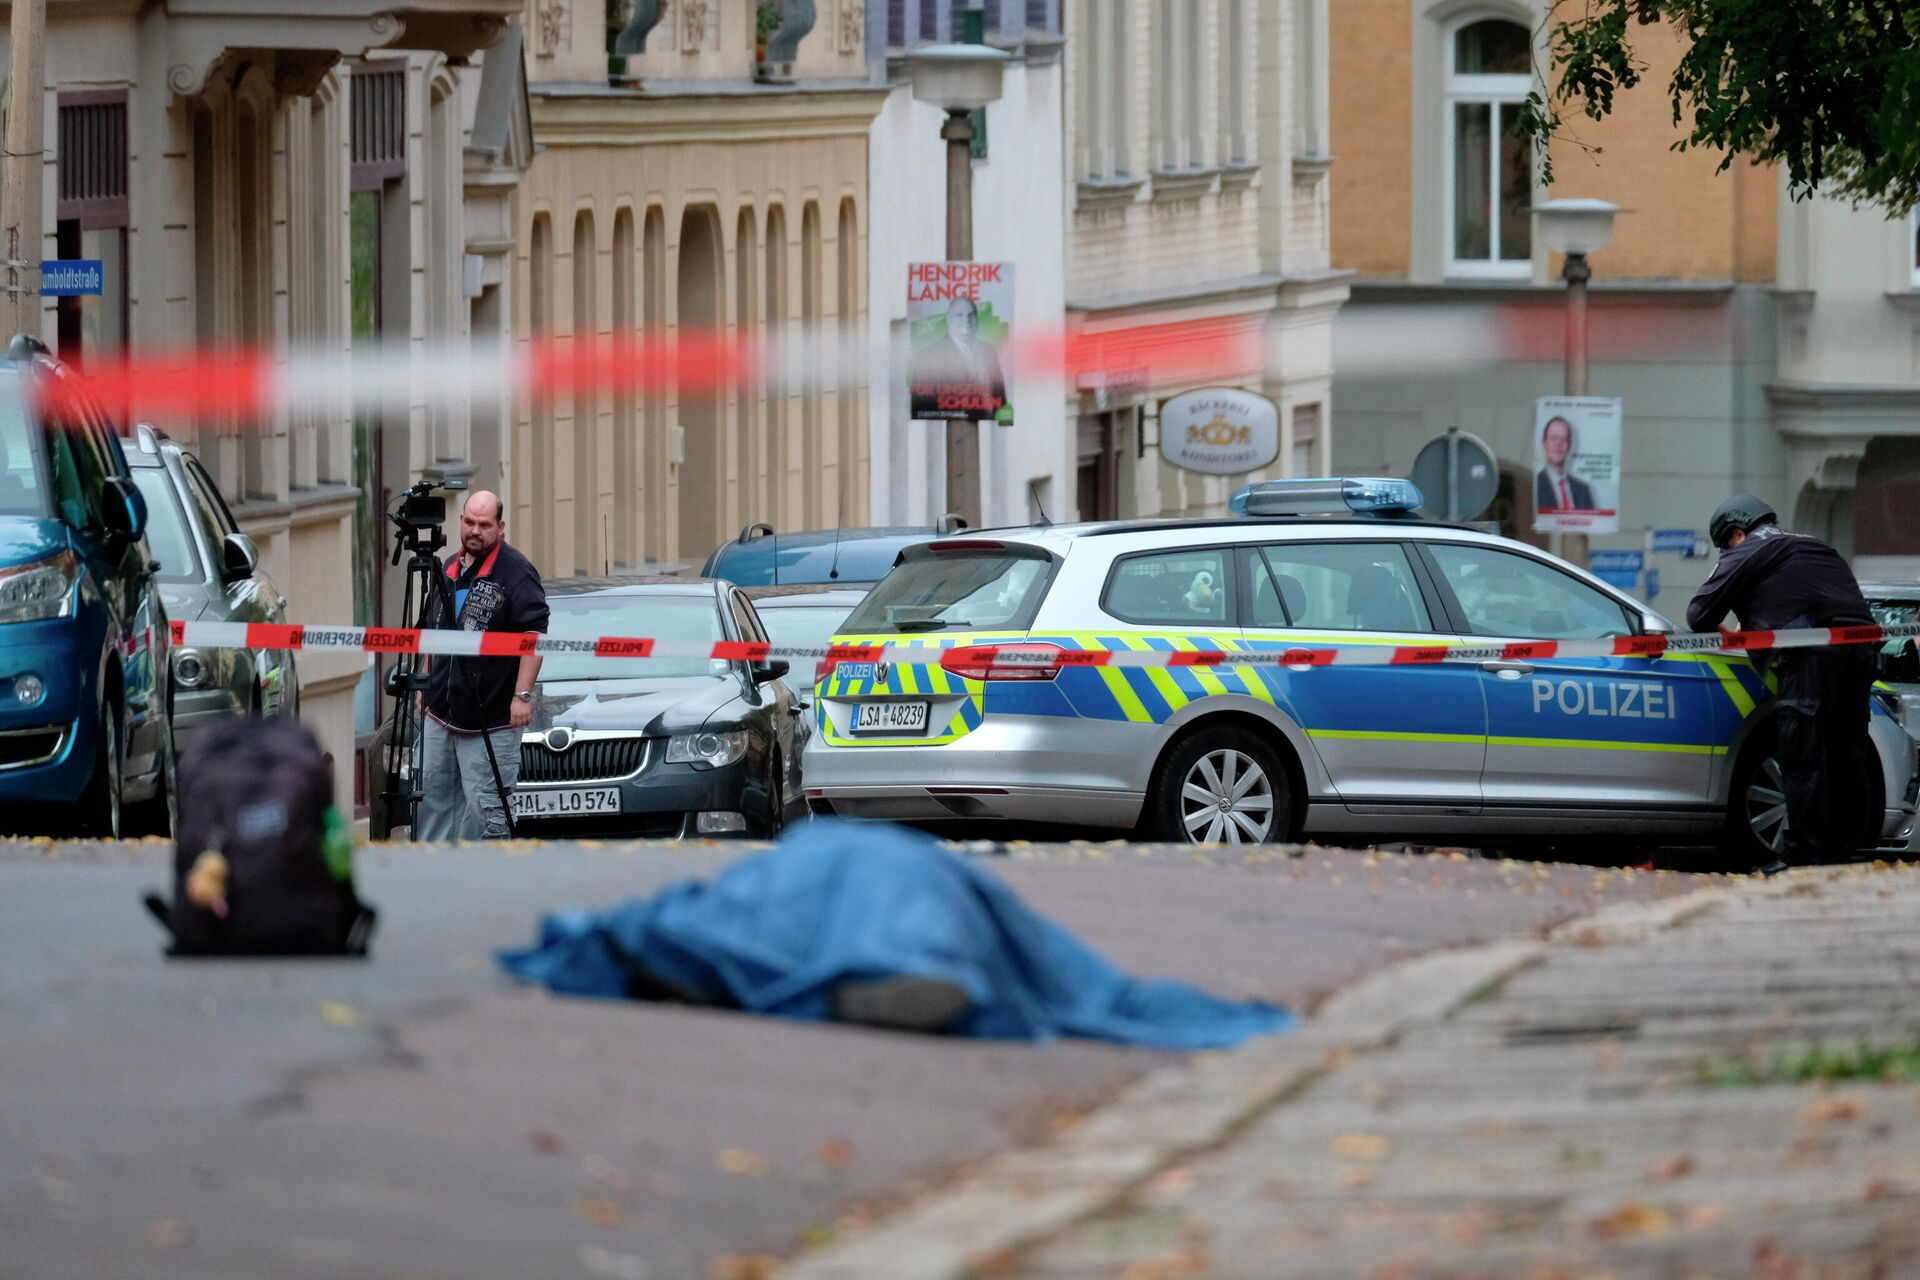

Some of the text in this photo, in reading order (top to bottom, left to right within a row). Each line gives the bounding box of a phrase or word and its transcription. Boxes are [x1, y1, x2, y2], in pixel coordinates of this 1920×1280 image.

[42, 266, 99, 289] umboldtstraße
[908, 263, 1003, 282] HENDRIK
[908, 283, 980, 301] LANGE
[837, 664, 872, 679] POLIZEI
[1531, 679, 1676, 719] POLIZEI
[858, 705, 924, 726] LSA 48239
[559, 792, 581, 811] LO
[585, 790, 617, 810] 574
